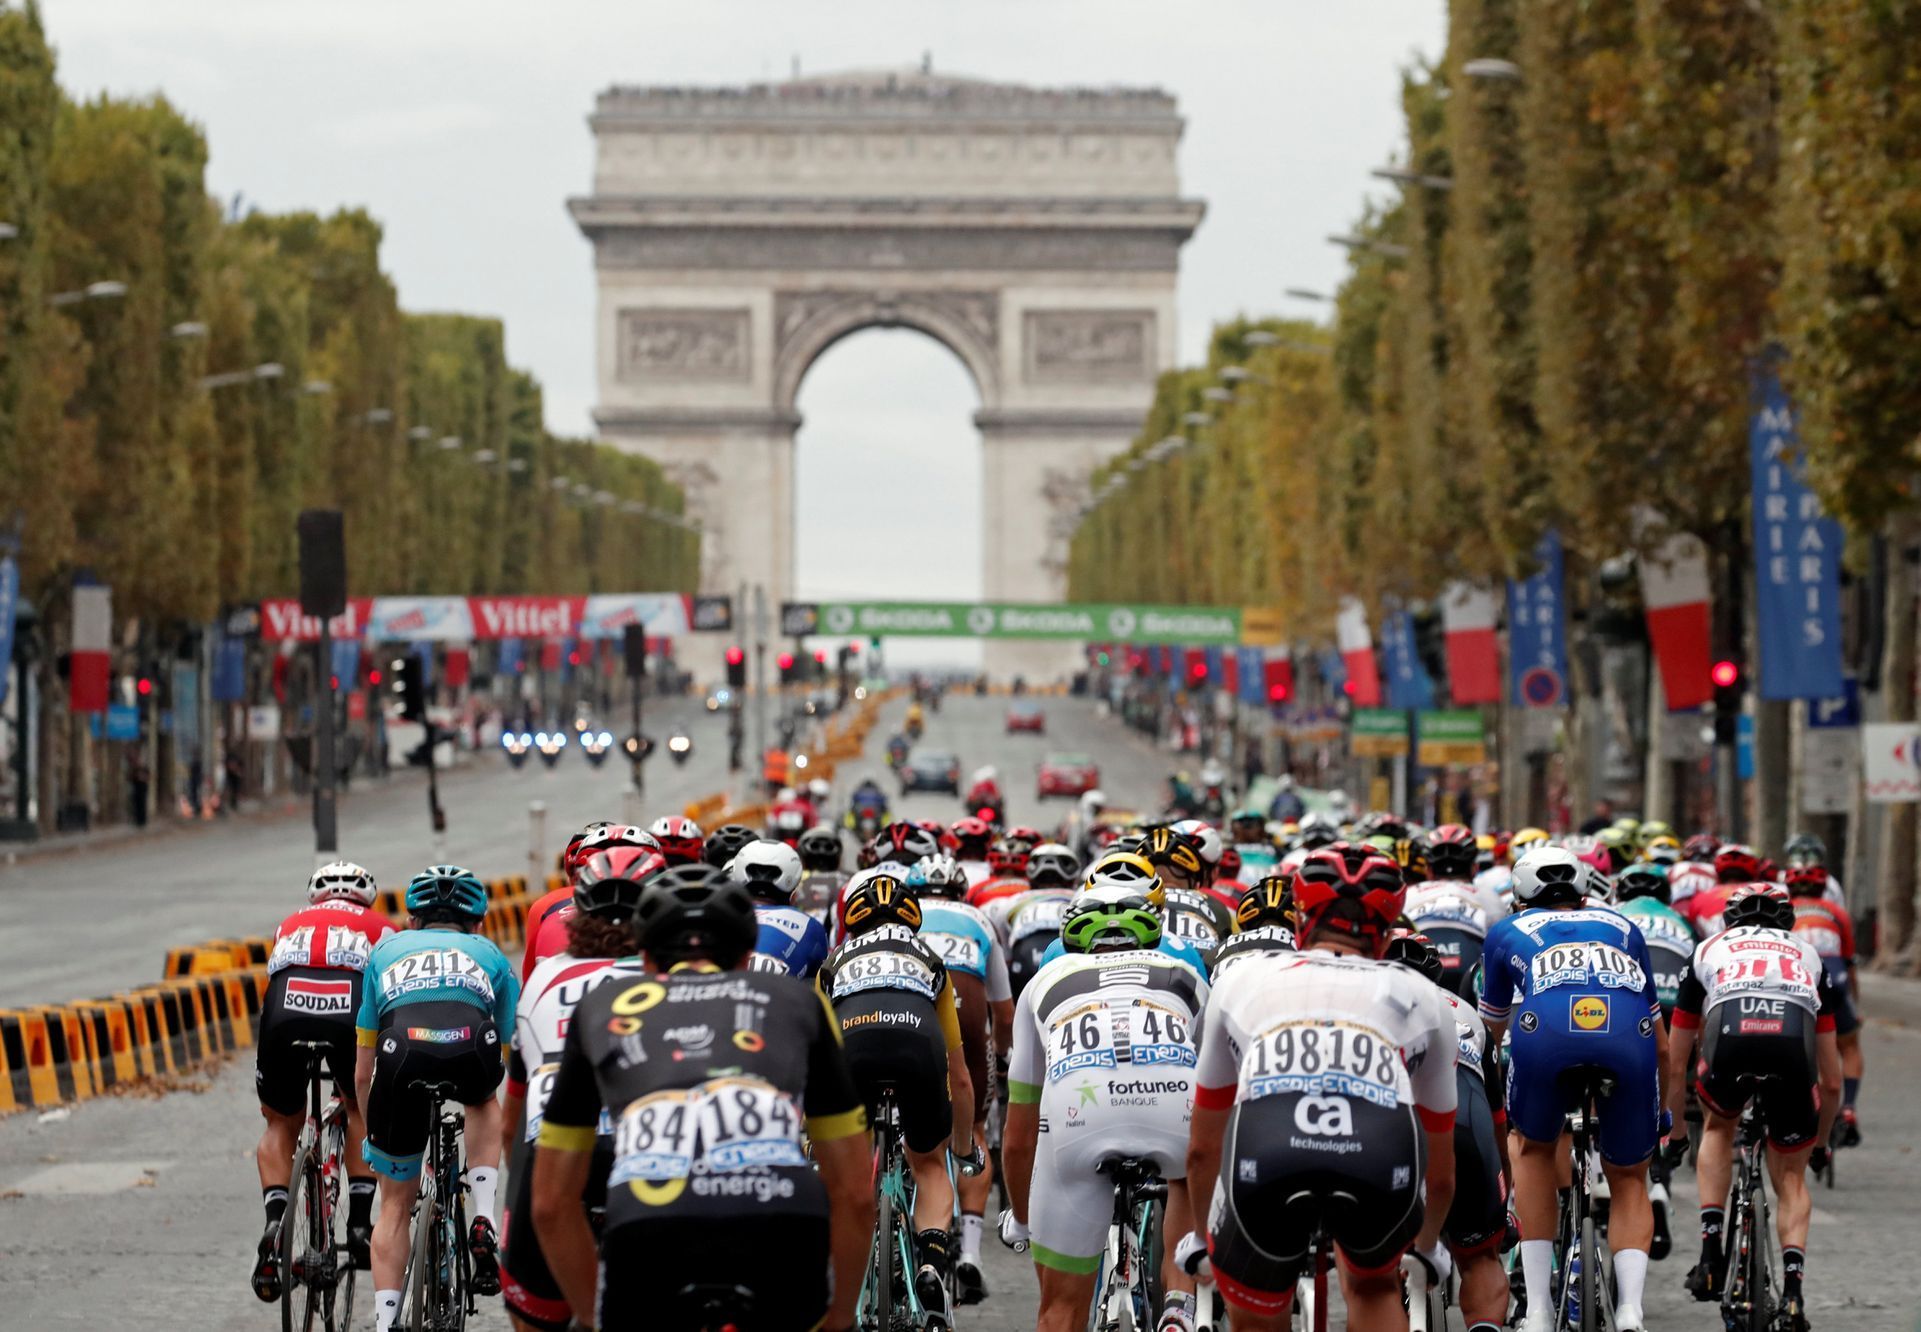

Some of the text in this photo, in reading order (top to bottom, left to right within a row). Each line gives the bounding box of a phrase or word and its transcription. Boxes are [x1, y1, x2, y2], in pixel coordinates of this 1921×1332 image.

[1758, 405, 1792, 585] MAIRIE
[1799, 493, 1825, 647] PARIS
[480, 600, 572, 636] Vittel
[943, 938, 972, 960] 24
[1731, 941, 1801, 959] Emirates
[386, 954, 440, 991] 124
[1537, 948, 1641, 982] 108 108
[1723, 960, 1755, 981] 91
[286, 993, 350, 1011] SOUDAL
[1740, 998, 1786, 1015] UAE
[843, 1010, 921, 1030] brandloyalty
[1143, 1010, 1187, 1045] 46
[1741, 1020, 1781, 1032] Emirates
[415, 1029, 465, 1041] MASSIGEN
[1060, 1013, 1100, 1054] 46
[1253, 1028, 1395, 1086] 198 198
[1108, 1080, 1189, 1095] fortuneo
[1111, 1098, 1159, 1107] BANQUE
[1294, 1094, 1354, 1136] ca
[620, 1089, 792, 1156] 184 184
[1290, 1136, 1363, 1155] technologies
[691, 1173, 795, 1203] energie
